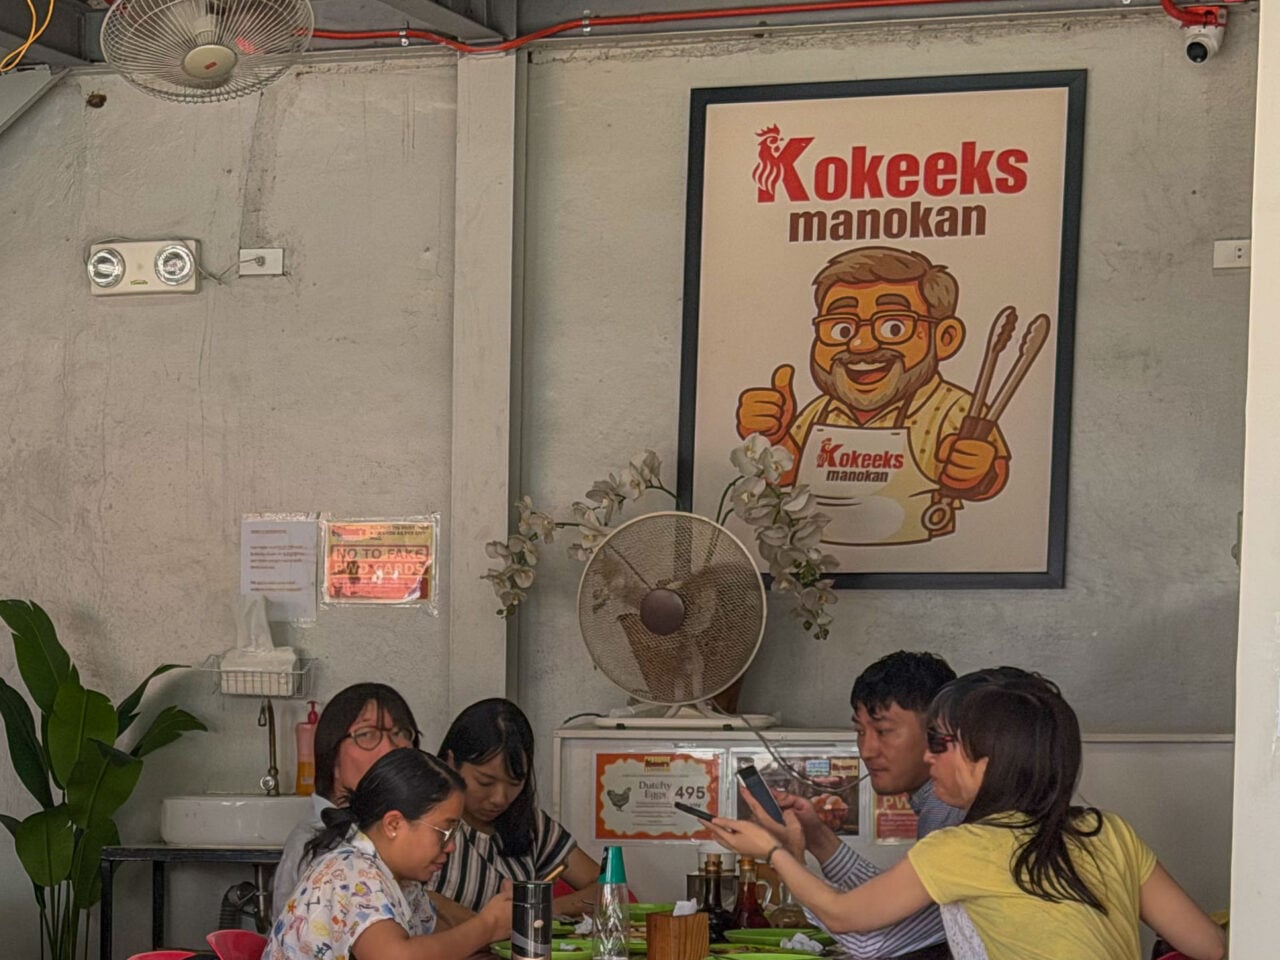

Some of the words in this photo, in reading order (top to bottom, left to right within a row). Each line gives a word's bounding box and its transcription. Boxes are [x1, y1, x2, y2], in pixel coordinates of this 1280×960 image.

[752, 123, 1029, 203] Kokeeks
[788, 201, 987, 242] manokan
[816, 437, 904, 469] Kokeeks
[826, 470, 889, 482] manokan
[336, 548, 358, 560] NO
[362, 548, 382, 559] TO
[387, 548, 424, 560] FAKE
[675, 786, 705, 799] 495
